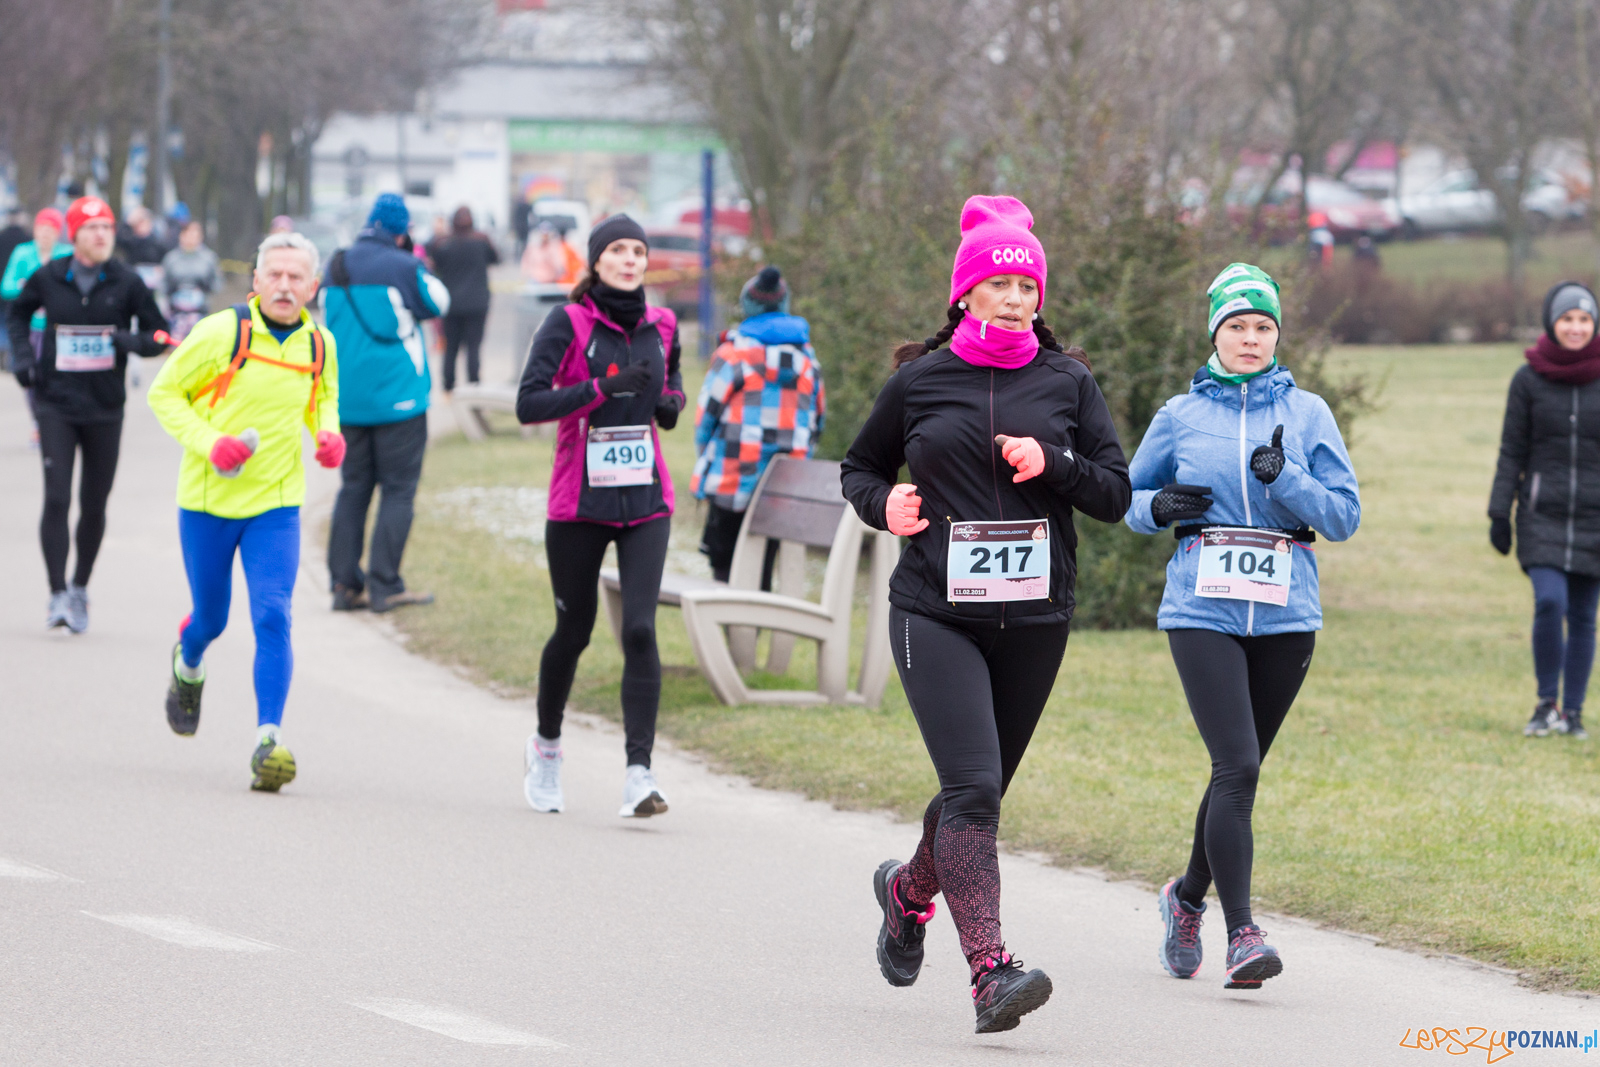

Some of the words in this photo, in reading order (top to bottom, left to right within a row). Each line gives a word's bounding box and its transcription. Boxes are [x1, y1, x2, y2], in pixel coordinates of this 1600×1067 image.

[992, 248, 1034, 265] COOL
[603, 445, 647, 465] 490
[969, 545, 1033, 573] 217
[1219, 550, 1275, 578] 104
